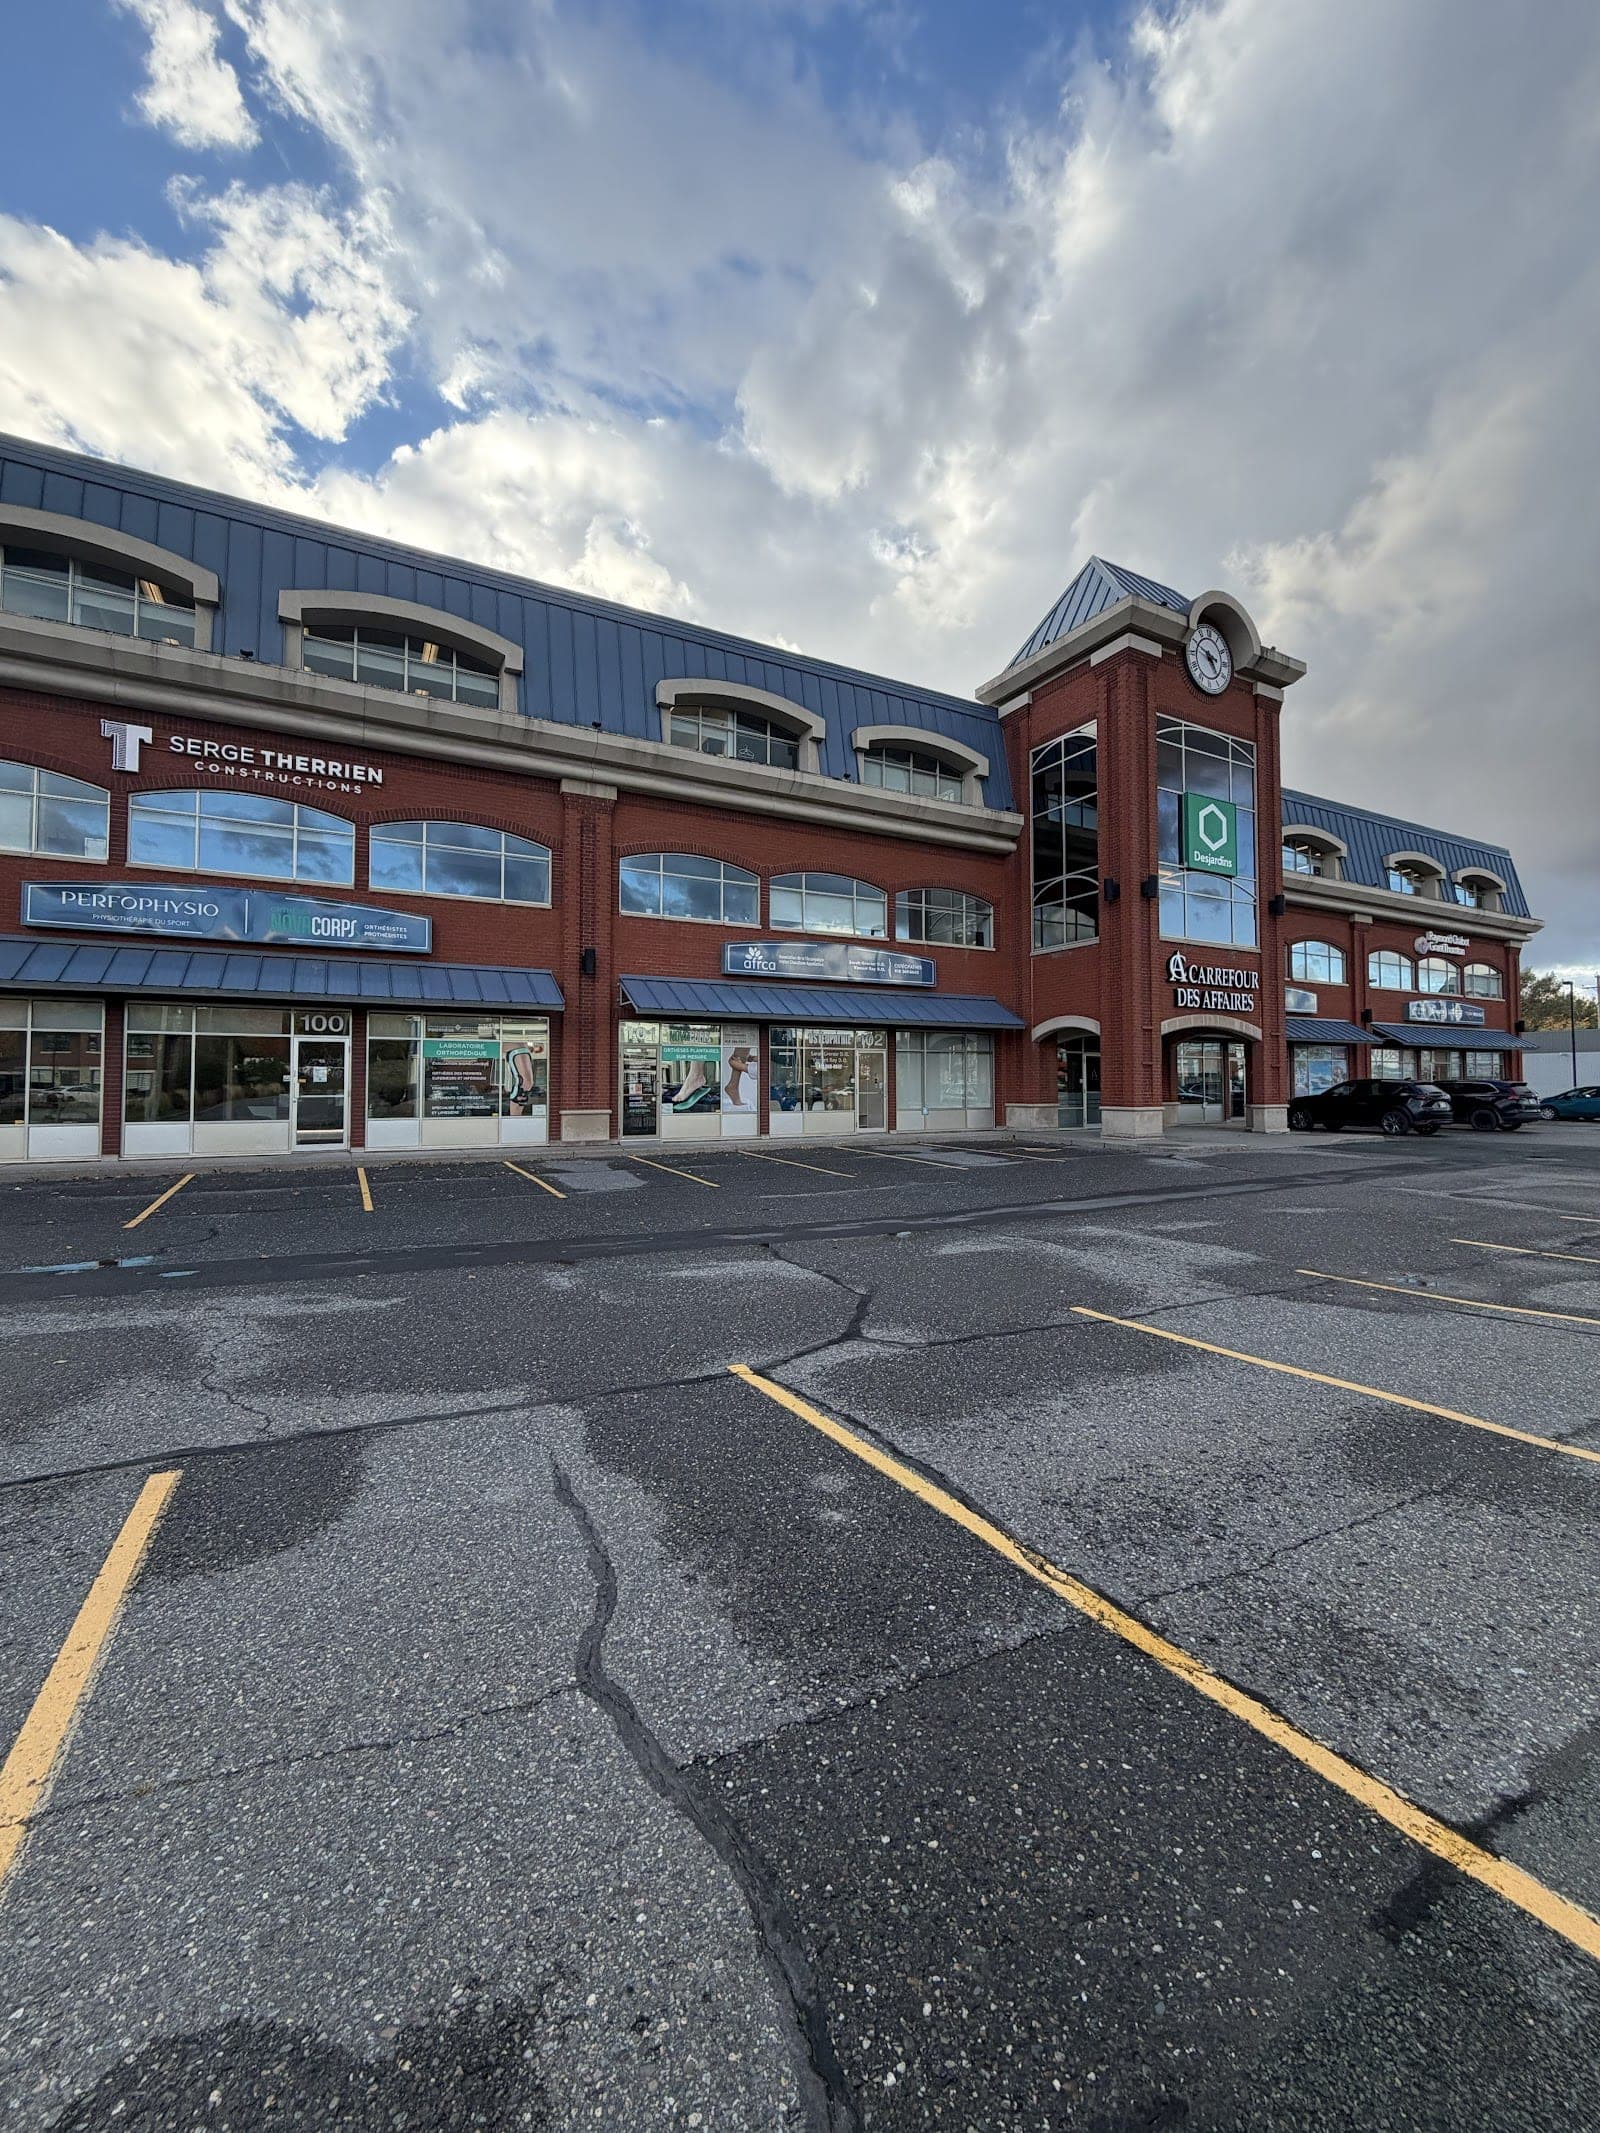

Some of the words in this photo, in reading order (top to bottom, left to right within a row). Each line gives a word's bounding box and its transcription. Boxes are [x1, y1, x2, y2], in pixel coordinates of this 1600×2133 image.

[169, 735, 255, 764] SERGE
[260, 749, 384, 784] THERRIEN
[194, 760, 362, 794] CONSTRUCTIONS
[1194, 850, 1232, 868] Desjardins
[60, 890, 219, 917] PERFOPHYSIO
[154, 917, 166, 925] DU
[167, 918, 190, 928] SPORT
[1188, 964, 1259, 989] CARREFOUR
[1177, 987, 1201, 1008] DES
[1202, 990, 1255, 1012] AFFAIRES
[300, 1014, 344, 1033] 100
